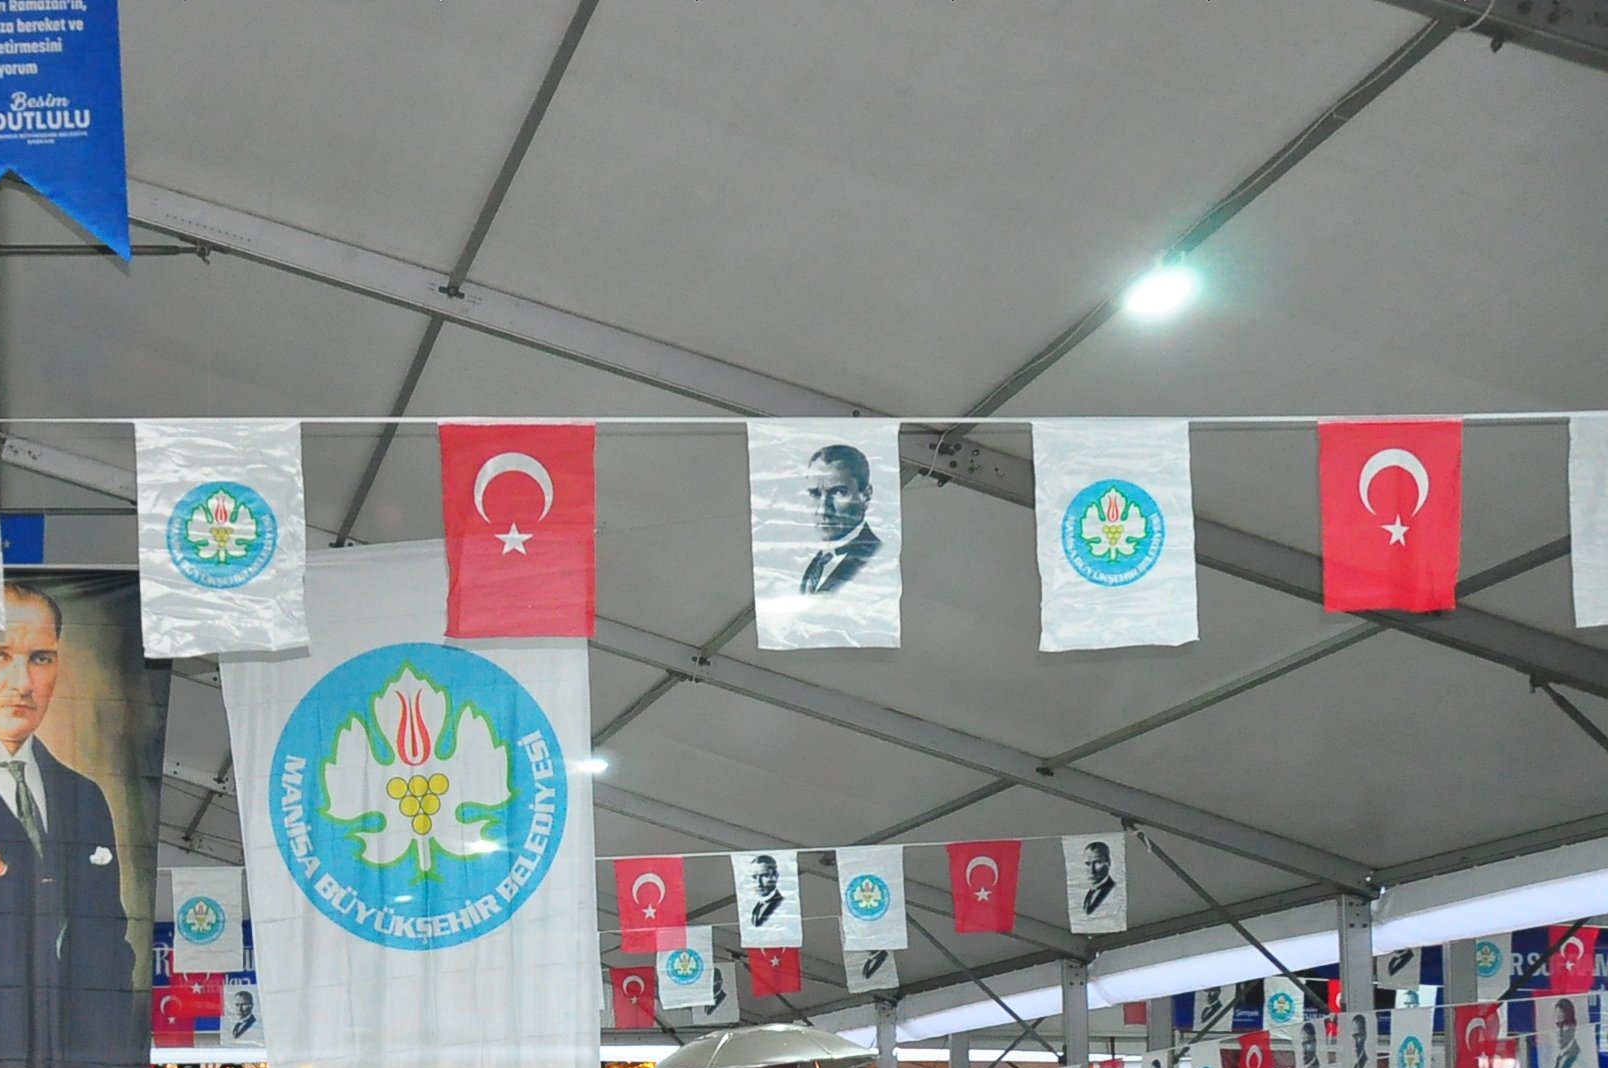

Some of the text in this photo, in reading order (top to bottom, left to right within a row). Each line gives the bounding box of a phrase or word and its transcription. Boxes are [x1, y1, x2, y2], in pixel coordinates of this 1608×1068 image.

[16, 17, 66, 33] bereket
[68, 19, 84, 31] ve
[10, 91, 70, 111] Besim
[281, 730, 555, 944] MANİSA BÜYÜKŞEHİR BELEDİYESİ
